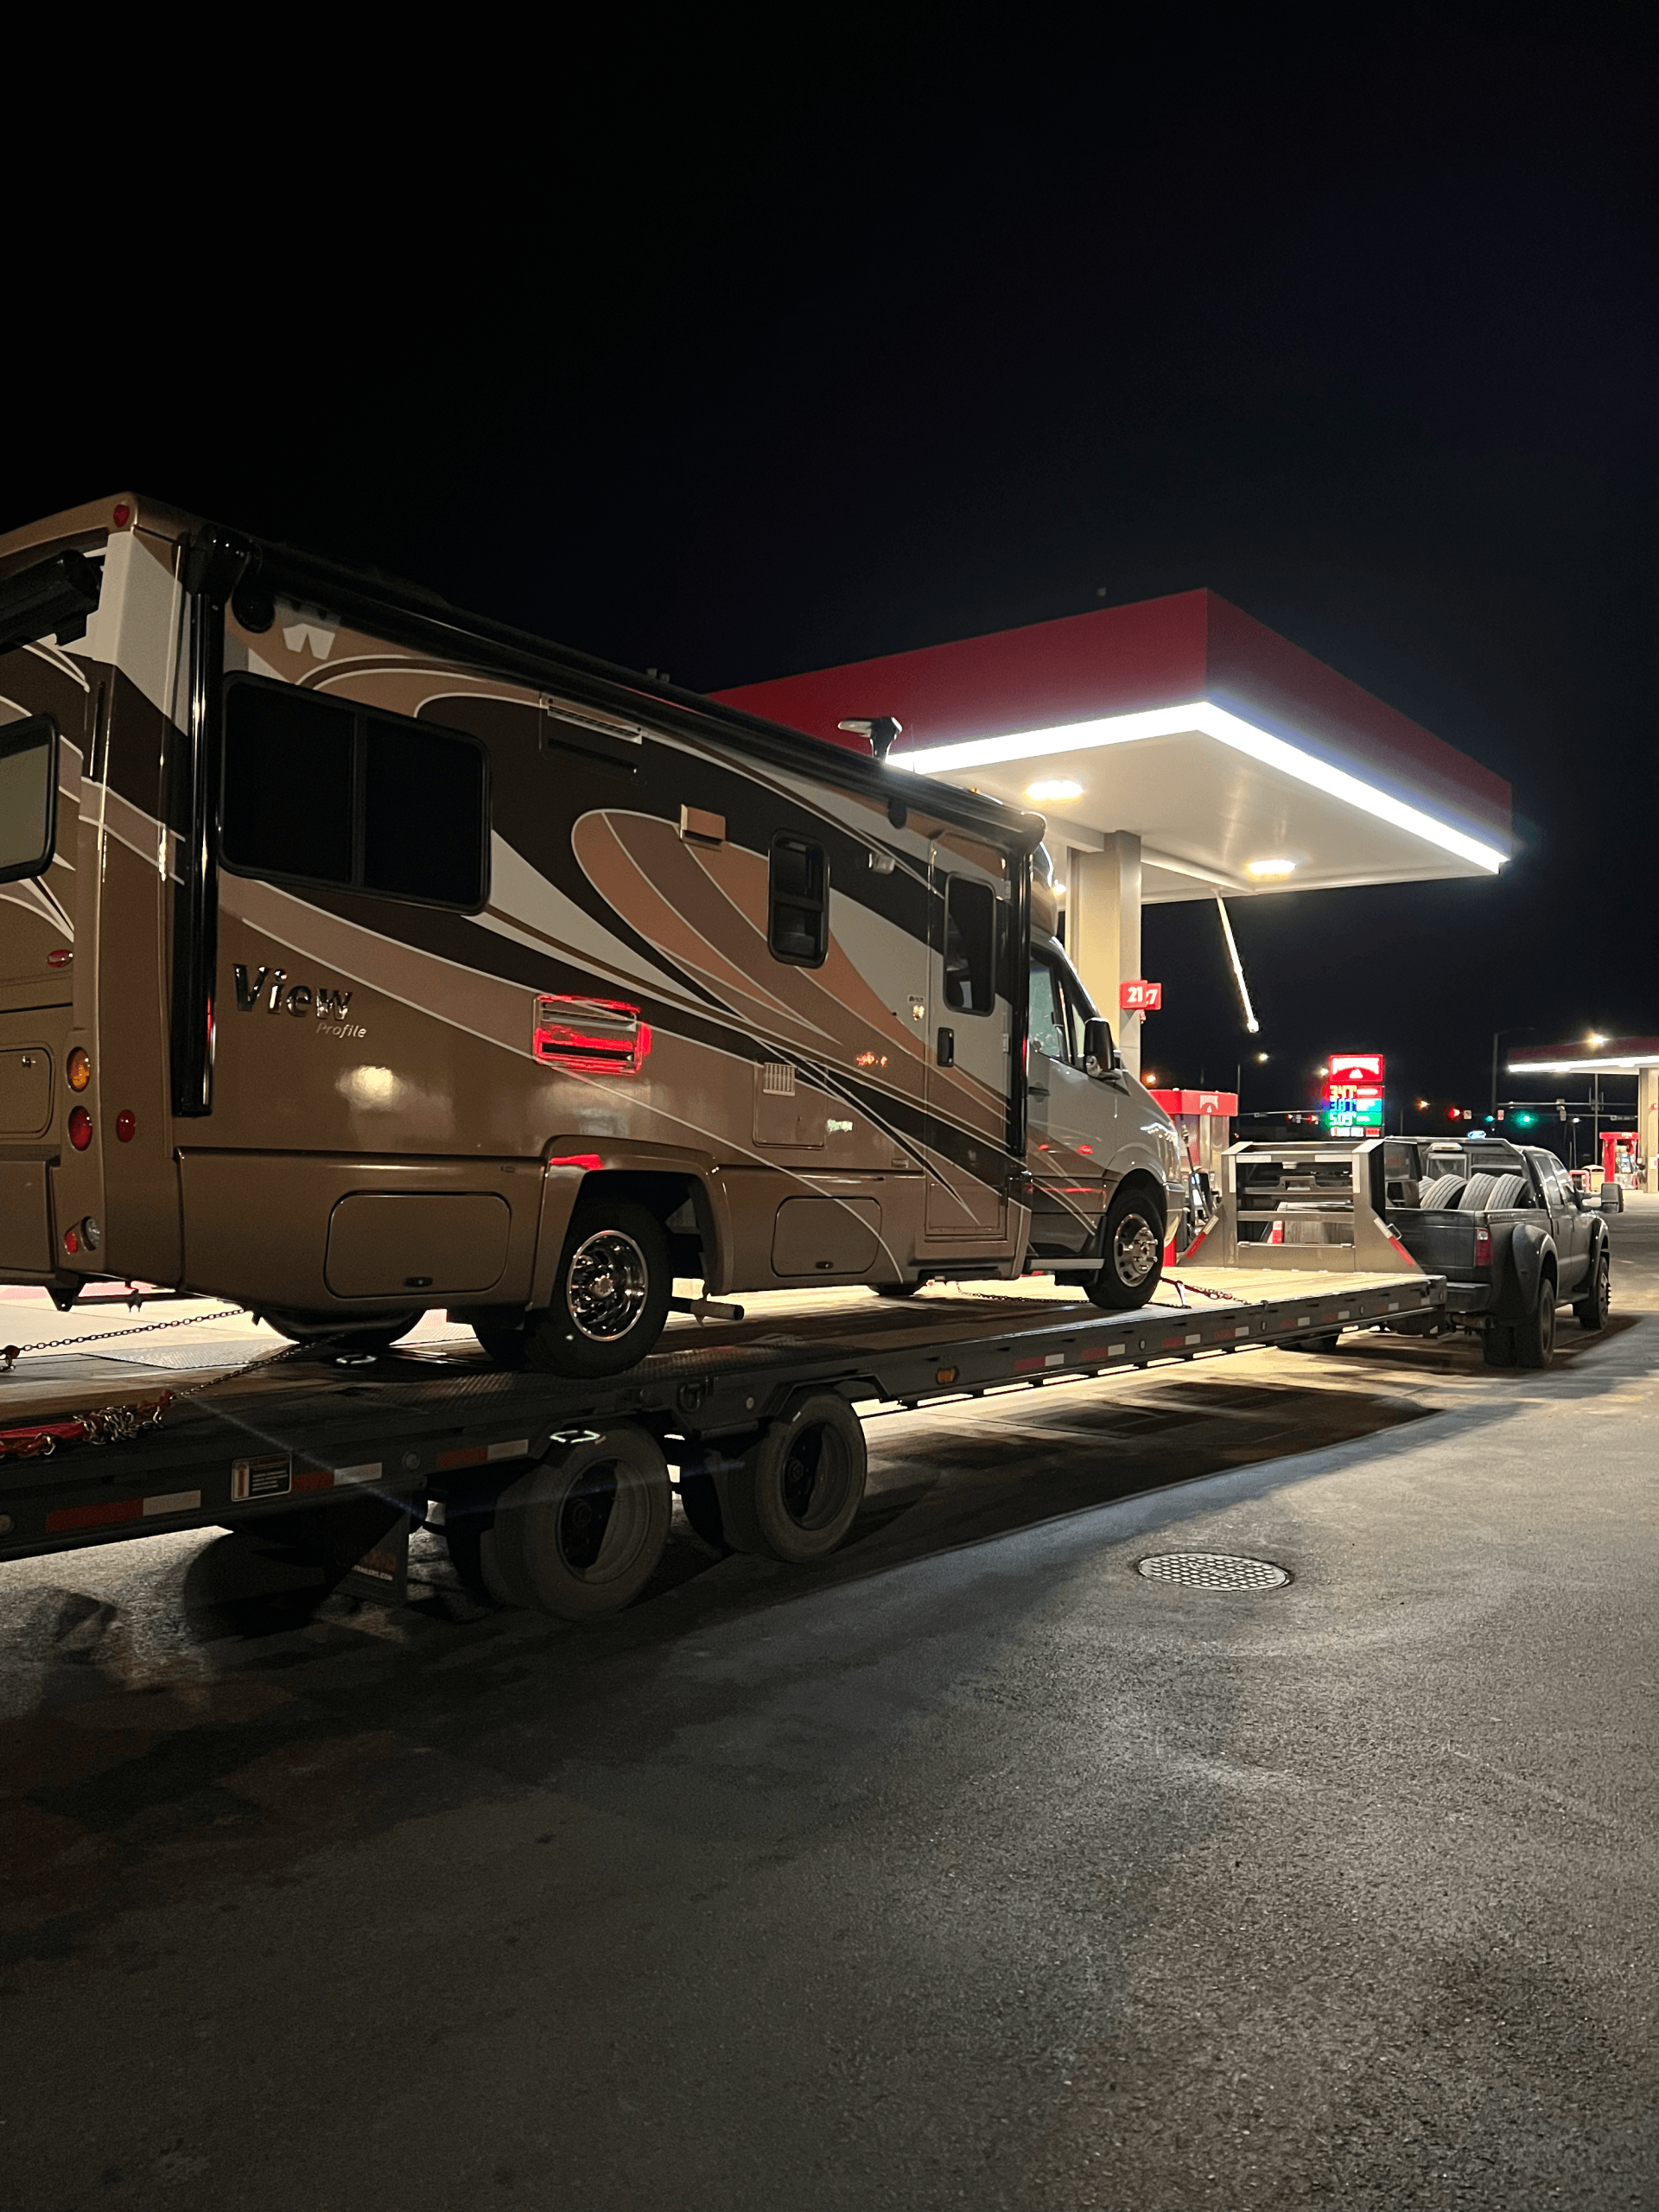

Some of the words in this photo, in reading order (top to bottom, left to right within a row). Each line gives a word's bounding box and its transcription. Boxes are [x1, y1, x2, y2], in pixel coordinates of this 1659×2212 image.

[232, 963, 353, 1021] View
[1127, 986, 1143, 1002] 21
[315, 1021, 367, 1039] Profile
